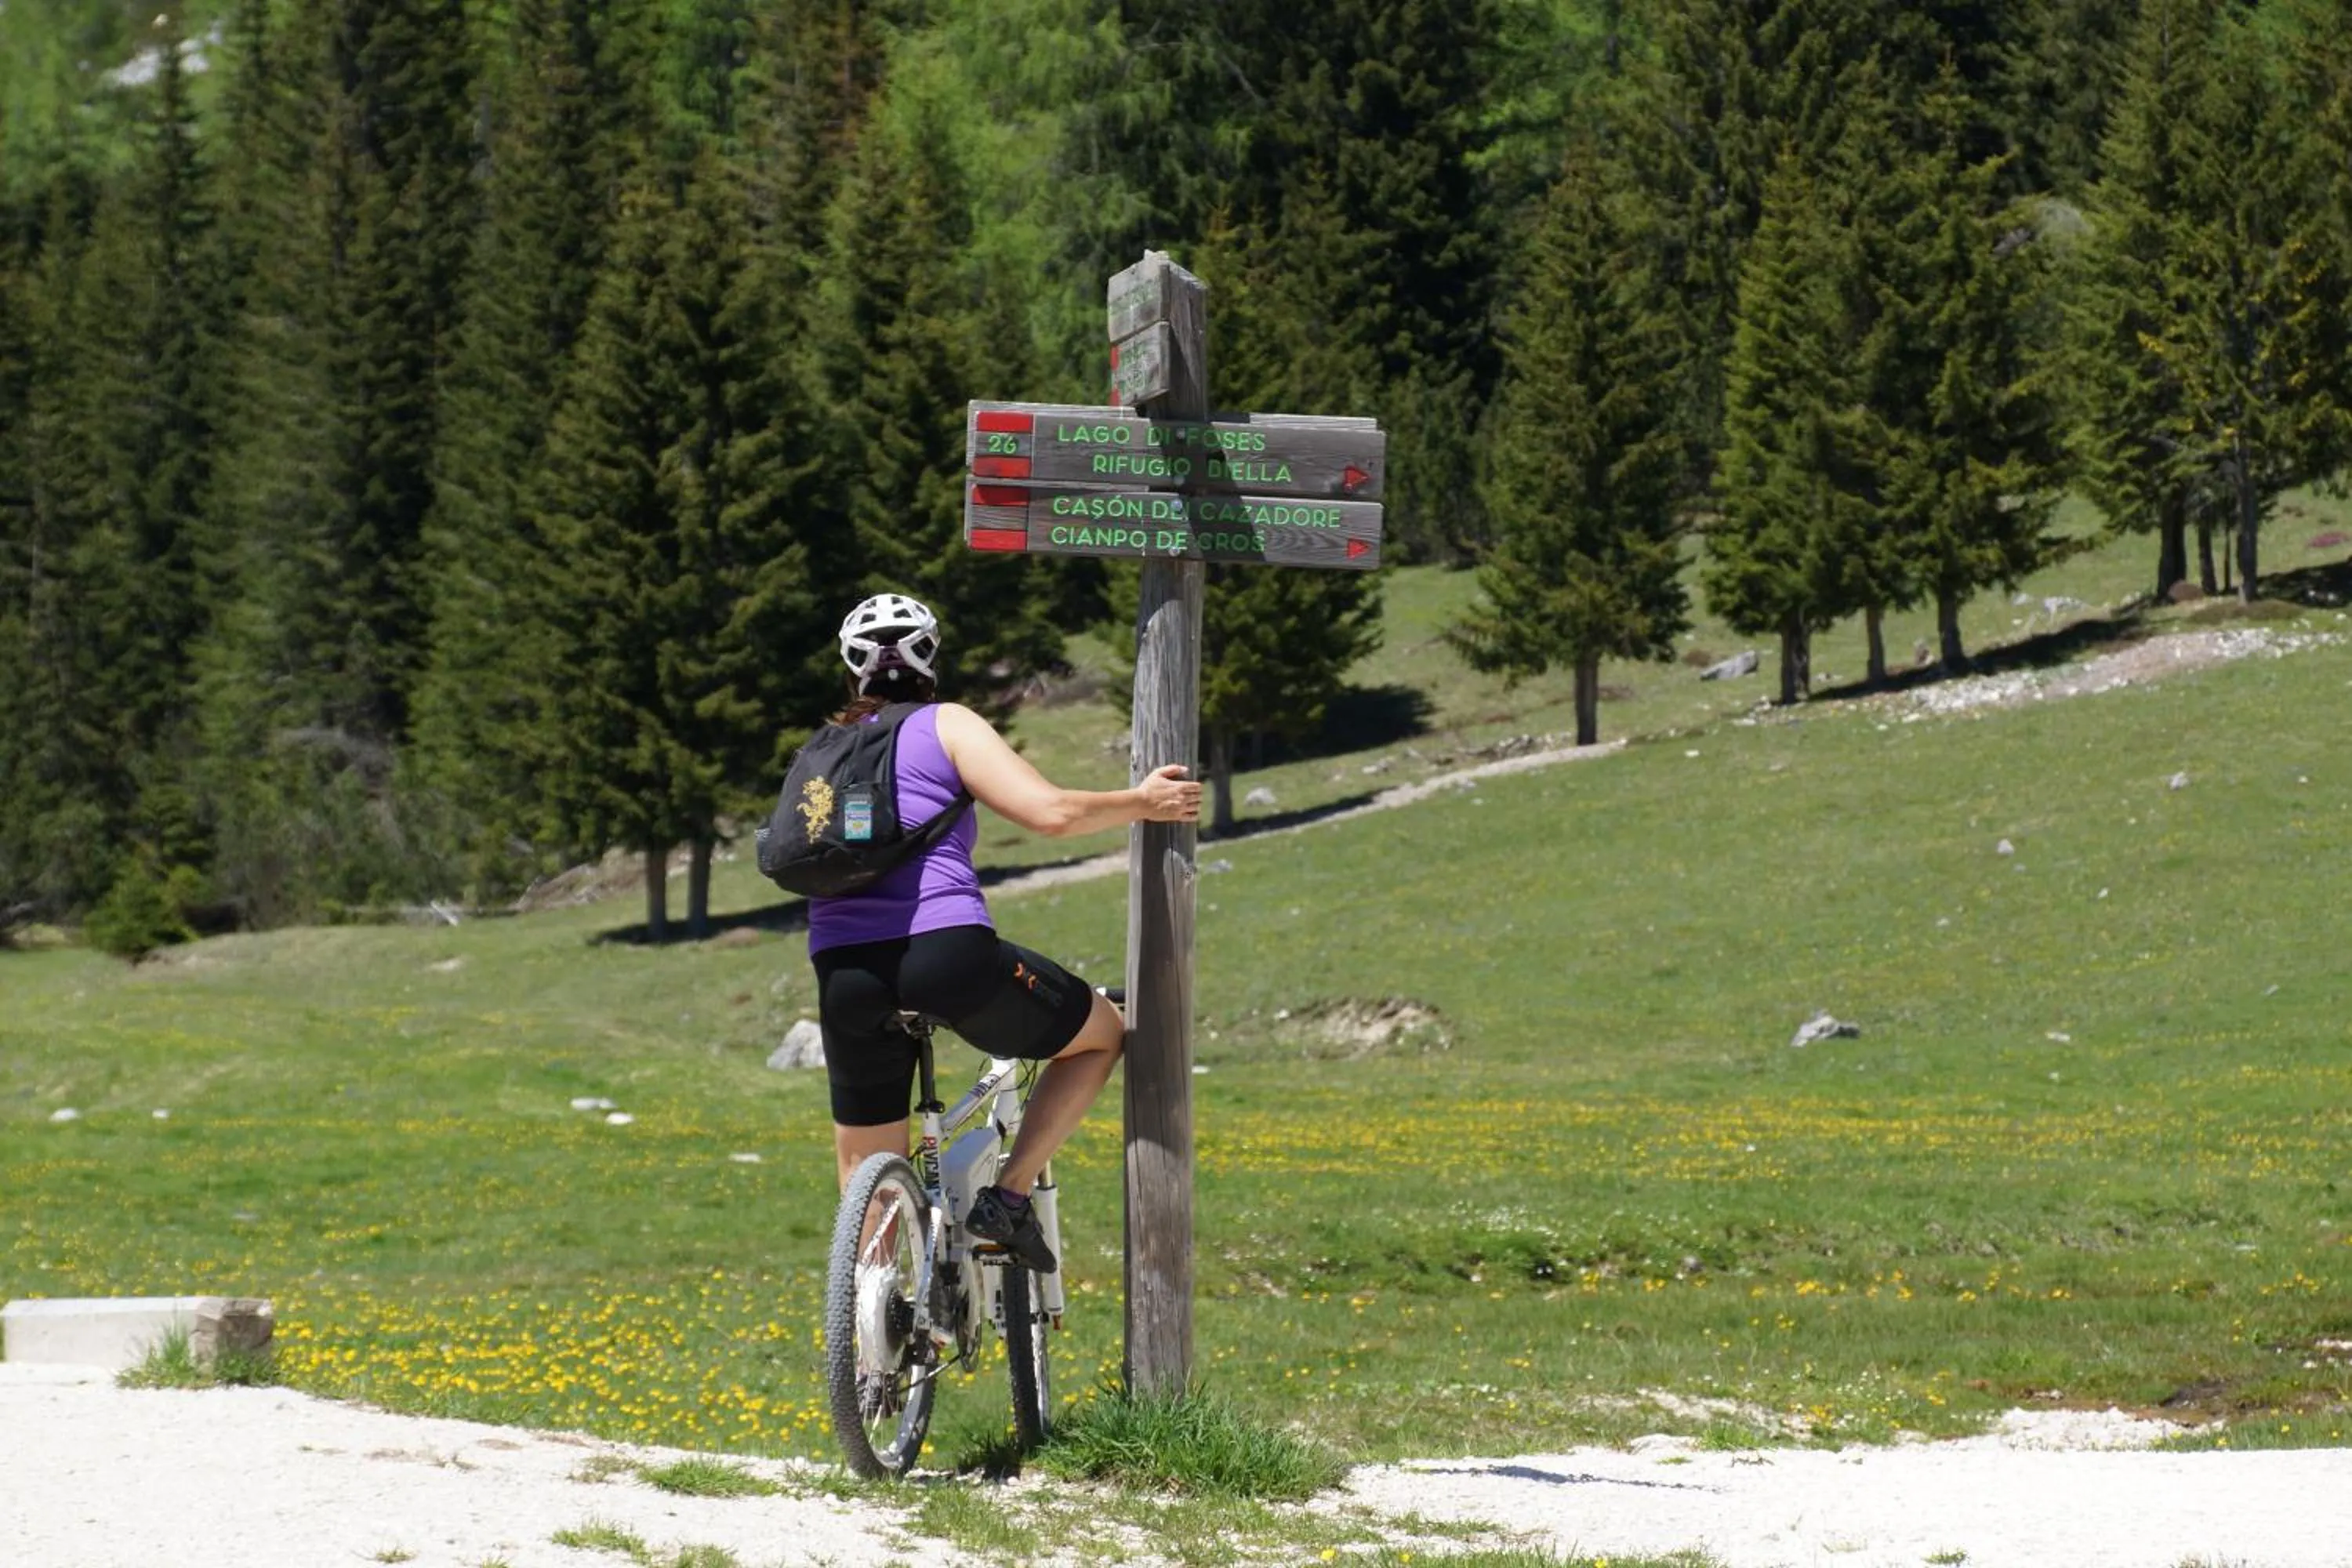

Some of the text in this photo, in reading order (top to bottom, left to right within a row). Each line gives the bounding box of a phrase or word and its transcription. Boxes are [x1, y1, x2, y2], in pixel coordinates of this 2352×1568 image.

[988, 434, 1017, 455] 26
[1058, 424, 1265, 452] LAGO DI FOSES
[1093, 454, 1190, 476] RIFUGIO
[1200, 502, 1341, 528] CAZADORE
[1051, 527, 1147, 547] CIANPO
[1156, 531, 1188, 551] DE
